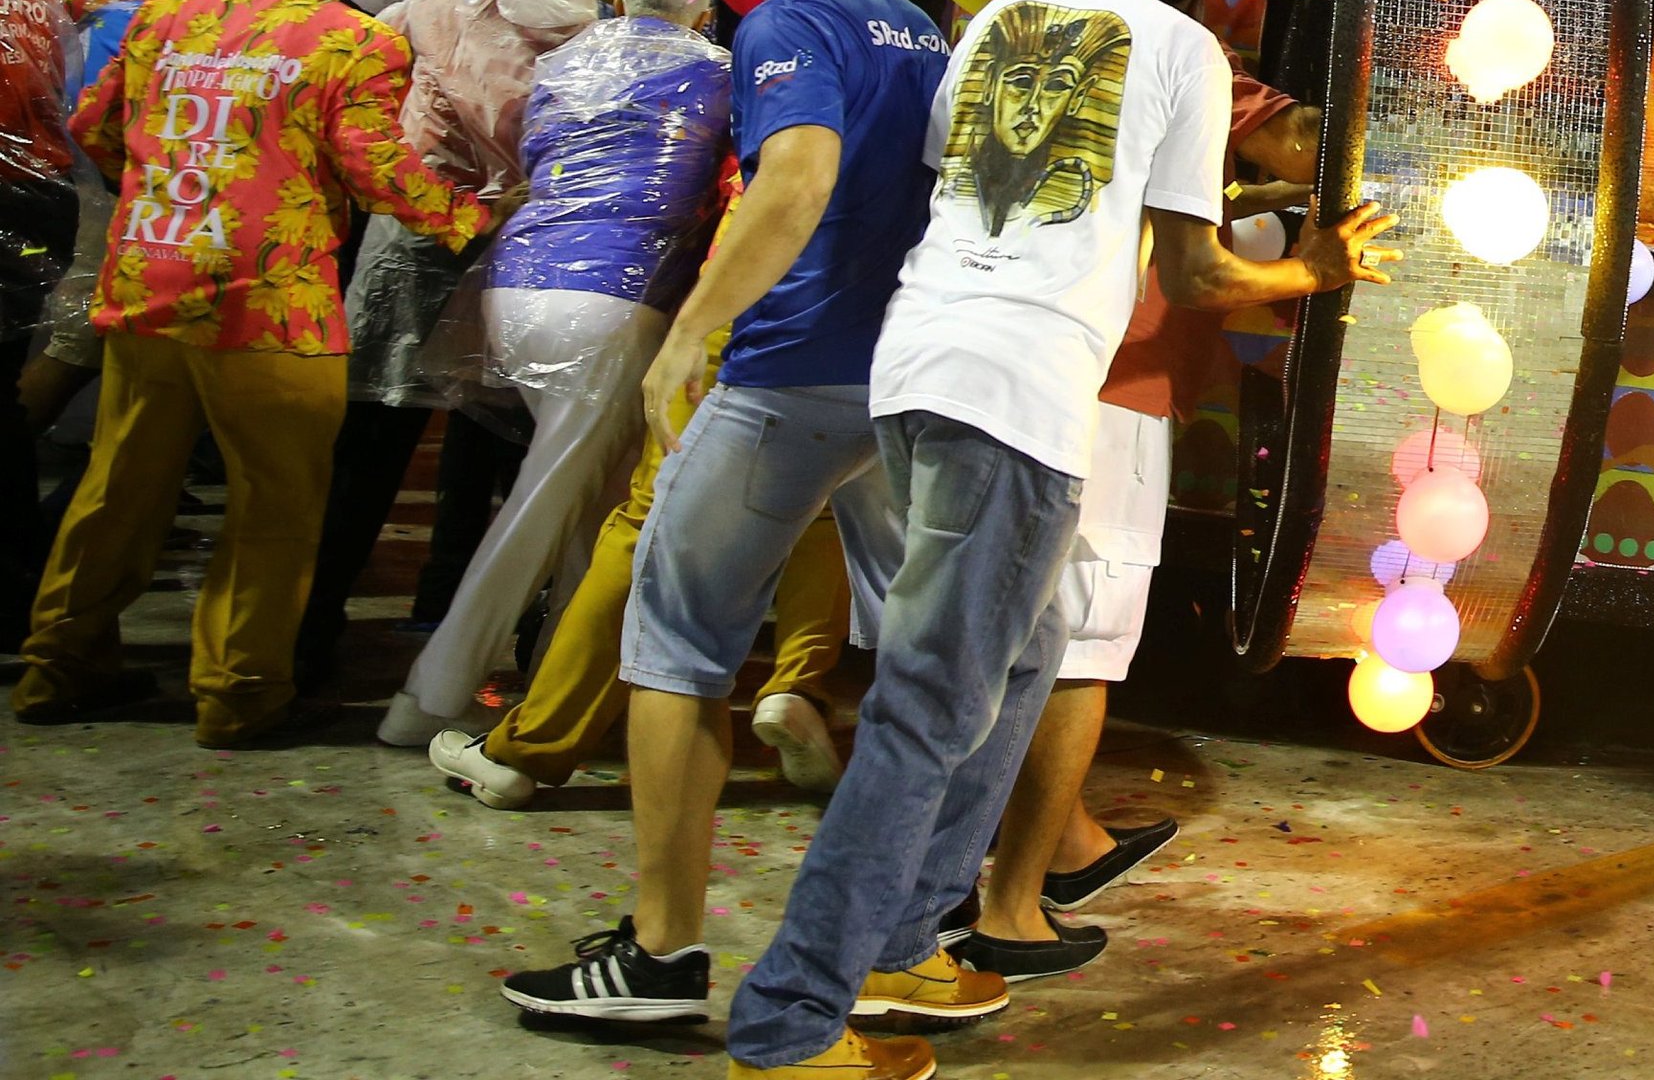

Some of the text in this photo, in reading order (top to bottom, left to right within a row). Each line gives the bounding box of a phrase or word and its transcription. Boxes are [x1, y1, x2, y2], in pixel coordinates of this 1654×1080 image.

[754, 54, 798, 85] SRzd
[156, 94, 239, 142] DI
[184, 141, 239, 169] RE
[143, 164, 210, 204] TO
[121, 199, 231, 250] RIA
